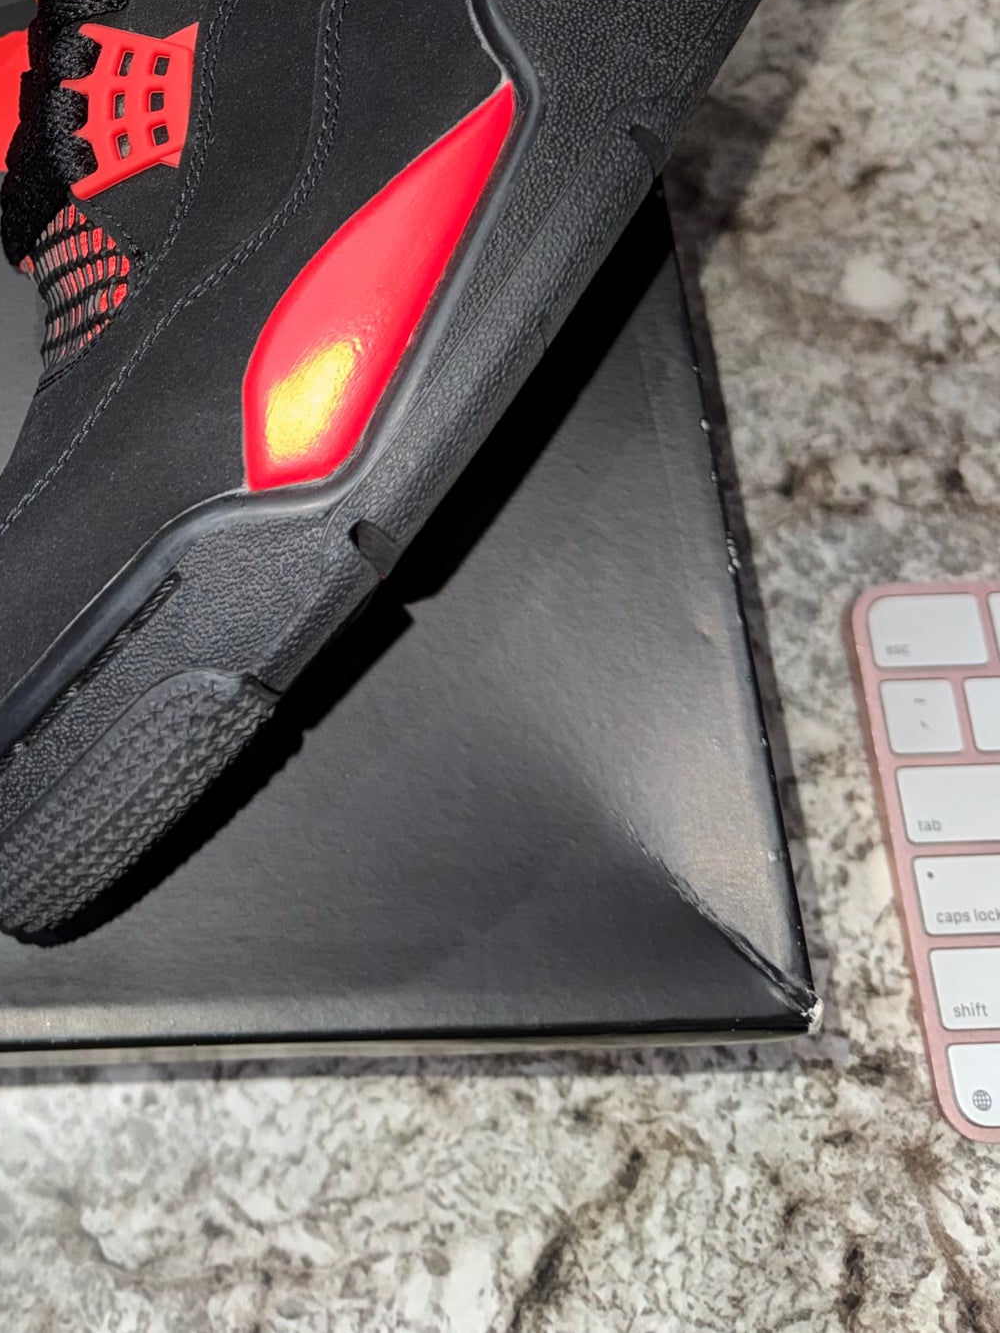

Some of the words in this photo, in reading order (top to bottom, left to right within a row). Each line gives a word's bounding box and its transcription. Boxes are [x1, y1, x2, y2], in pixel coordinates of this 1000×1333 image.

[917, 818, 942, 832] tab
[936, 910, 971, 925] caps
[952, 1001, 988, 1018] shift
